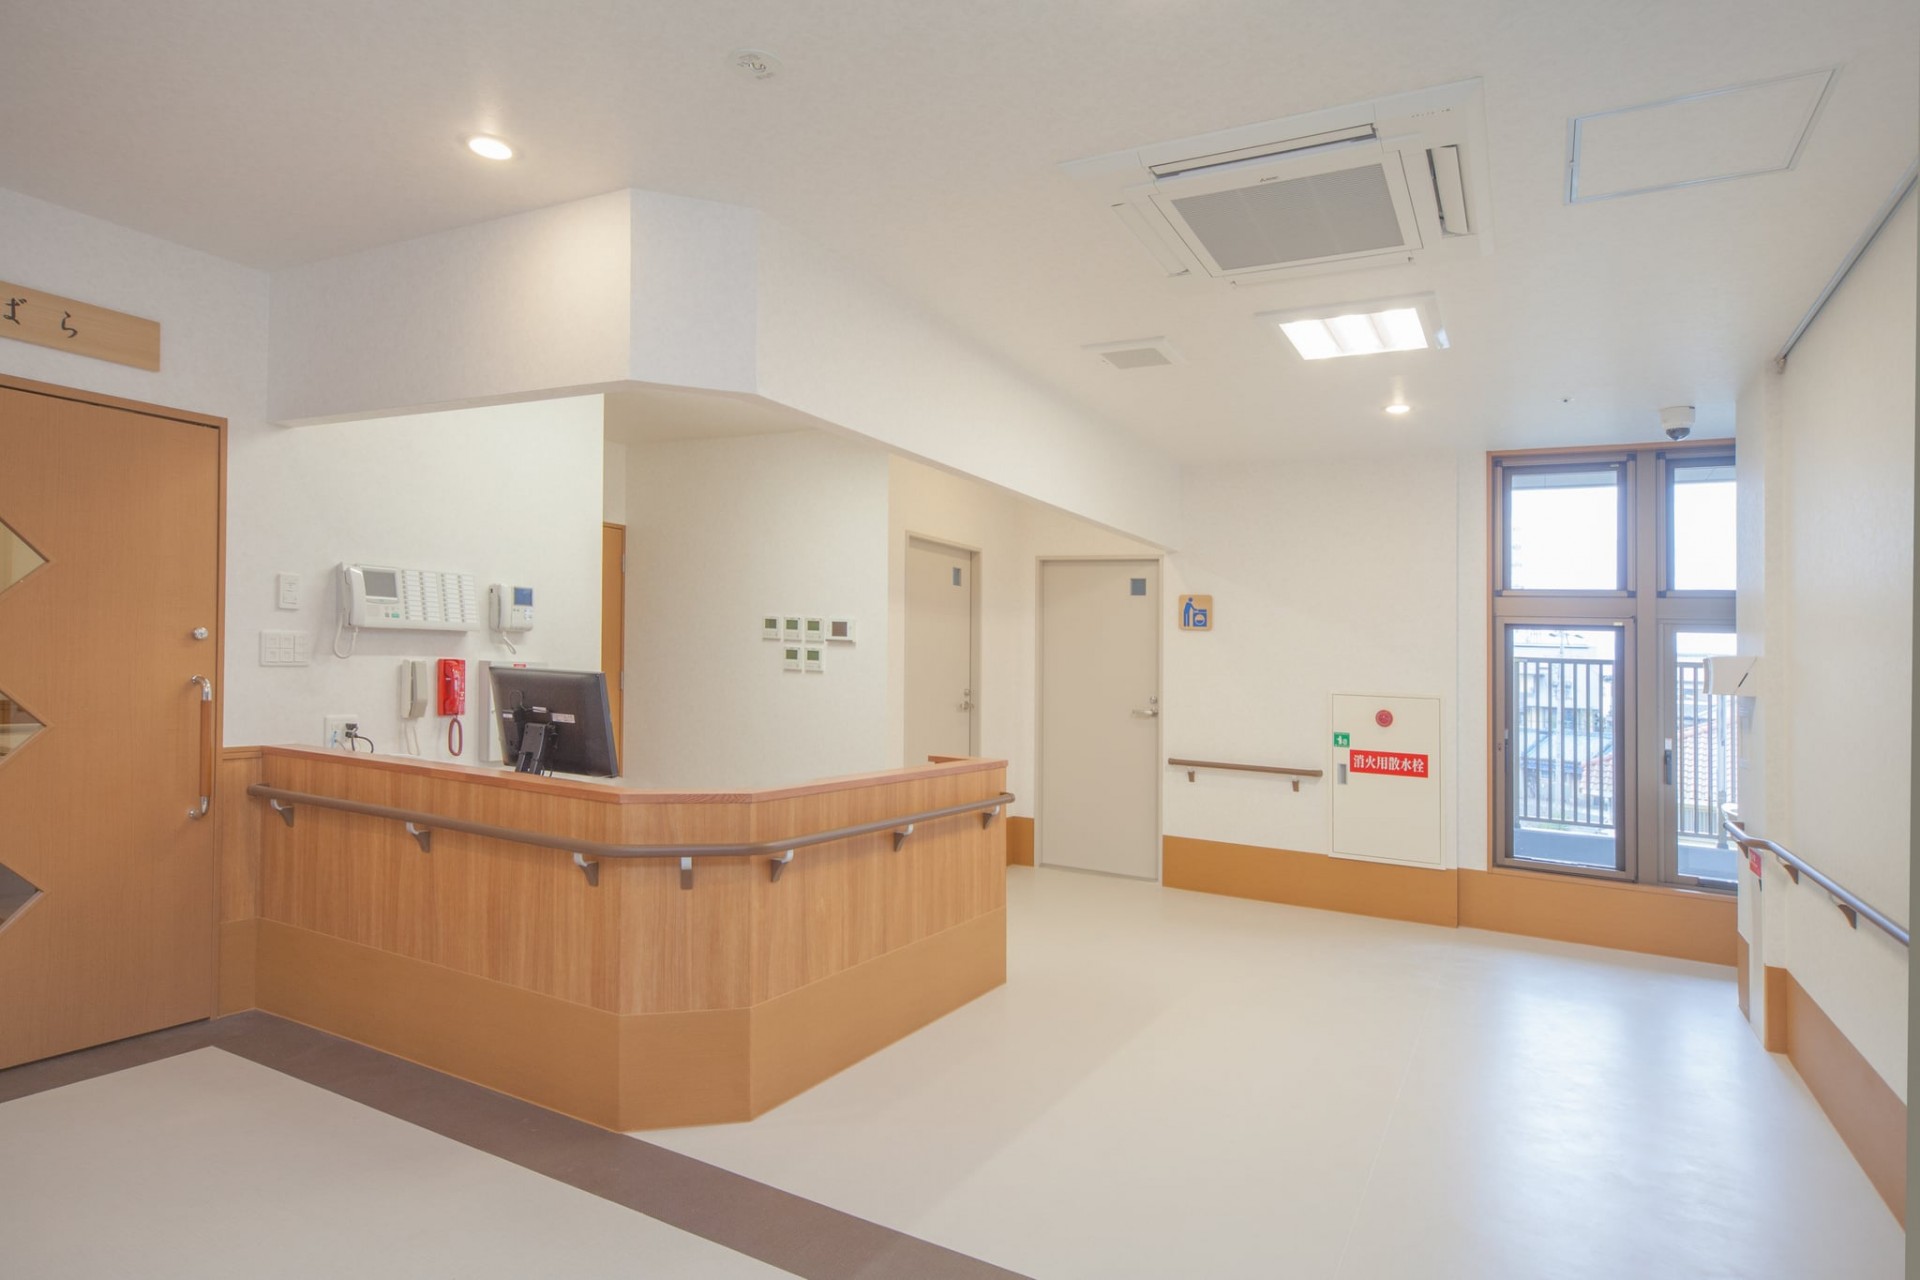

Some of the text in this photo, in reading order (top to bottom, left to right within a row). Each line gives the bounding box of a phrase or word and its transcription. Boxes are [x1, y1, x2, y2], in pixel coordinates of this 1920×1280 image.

[1353, 754, 1424, 773] 消火用散水栓
